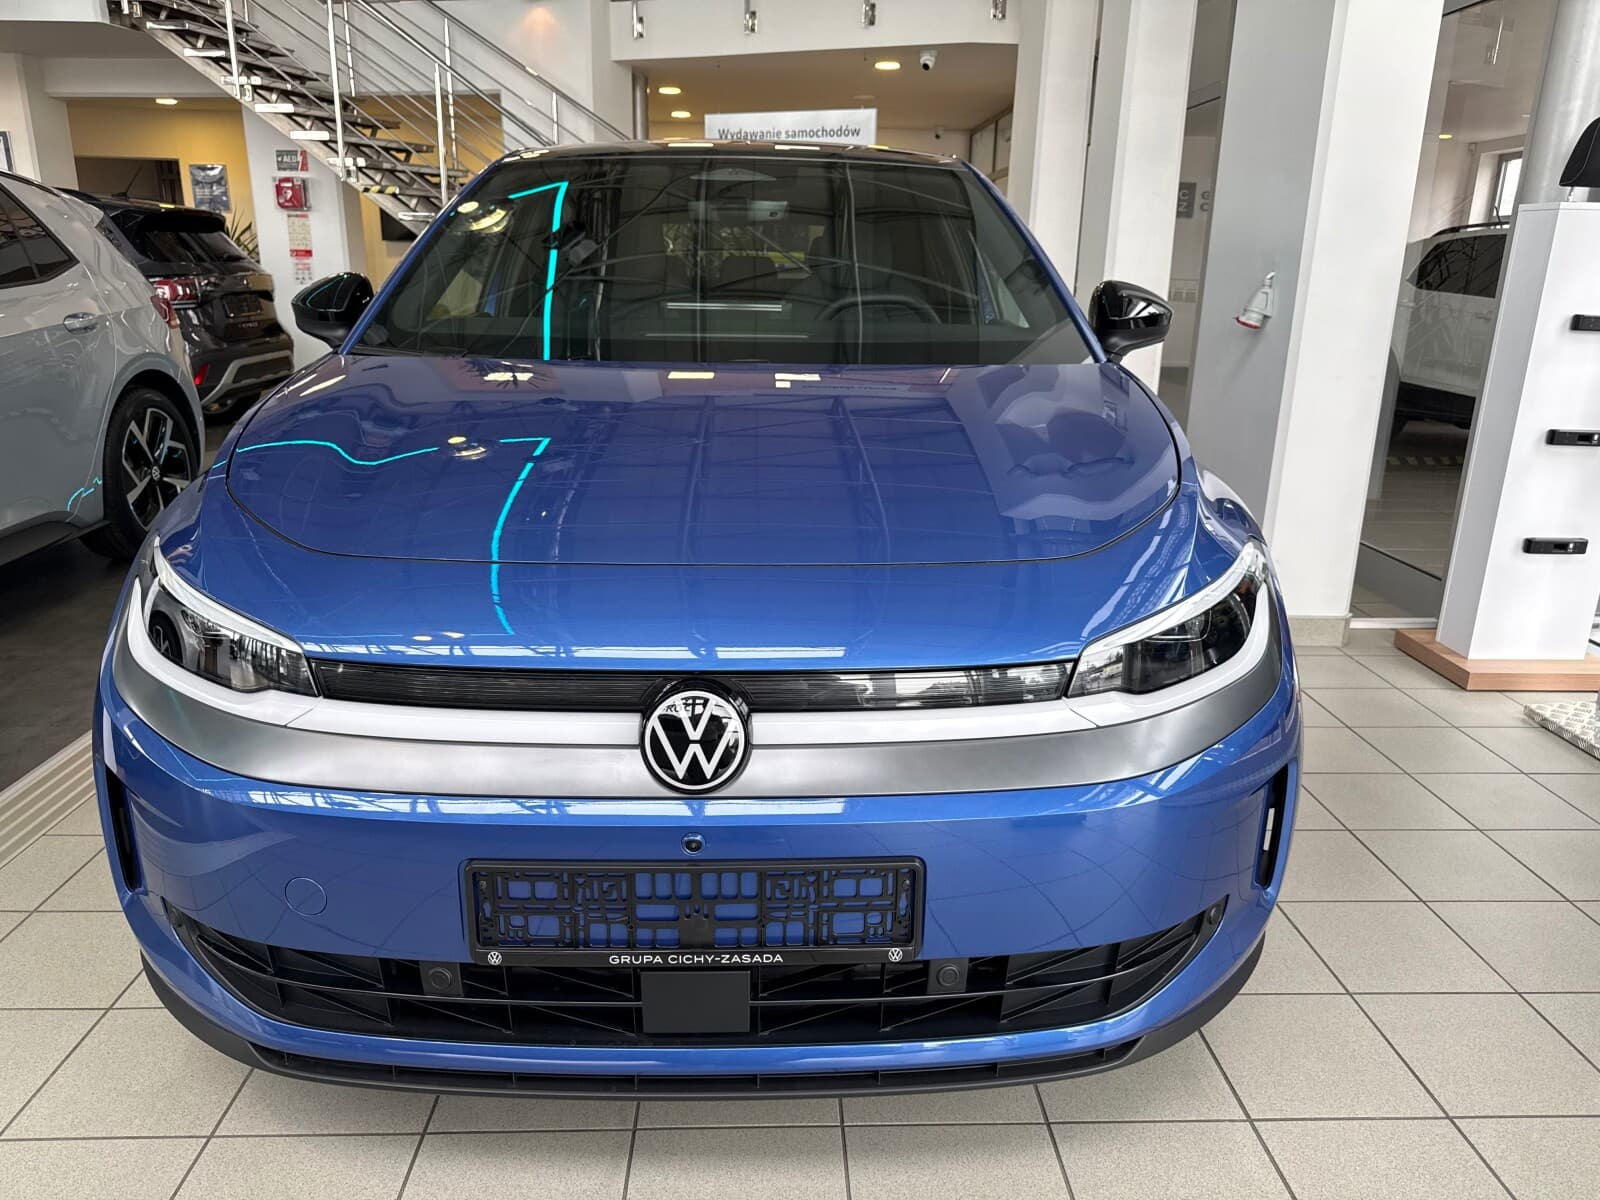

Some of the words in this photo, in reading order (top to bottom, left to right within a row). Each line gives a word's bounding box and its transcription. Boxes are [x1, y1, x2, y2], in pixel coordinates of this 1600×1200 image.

[718, 127, 782, 140] Wydawanie
[785, 125, 861, 139] samochodów
[609, 954, 663, 964] GRUPA
[668, 954, 784, 964] CICHY-ZASADA
